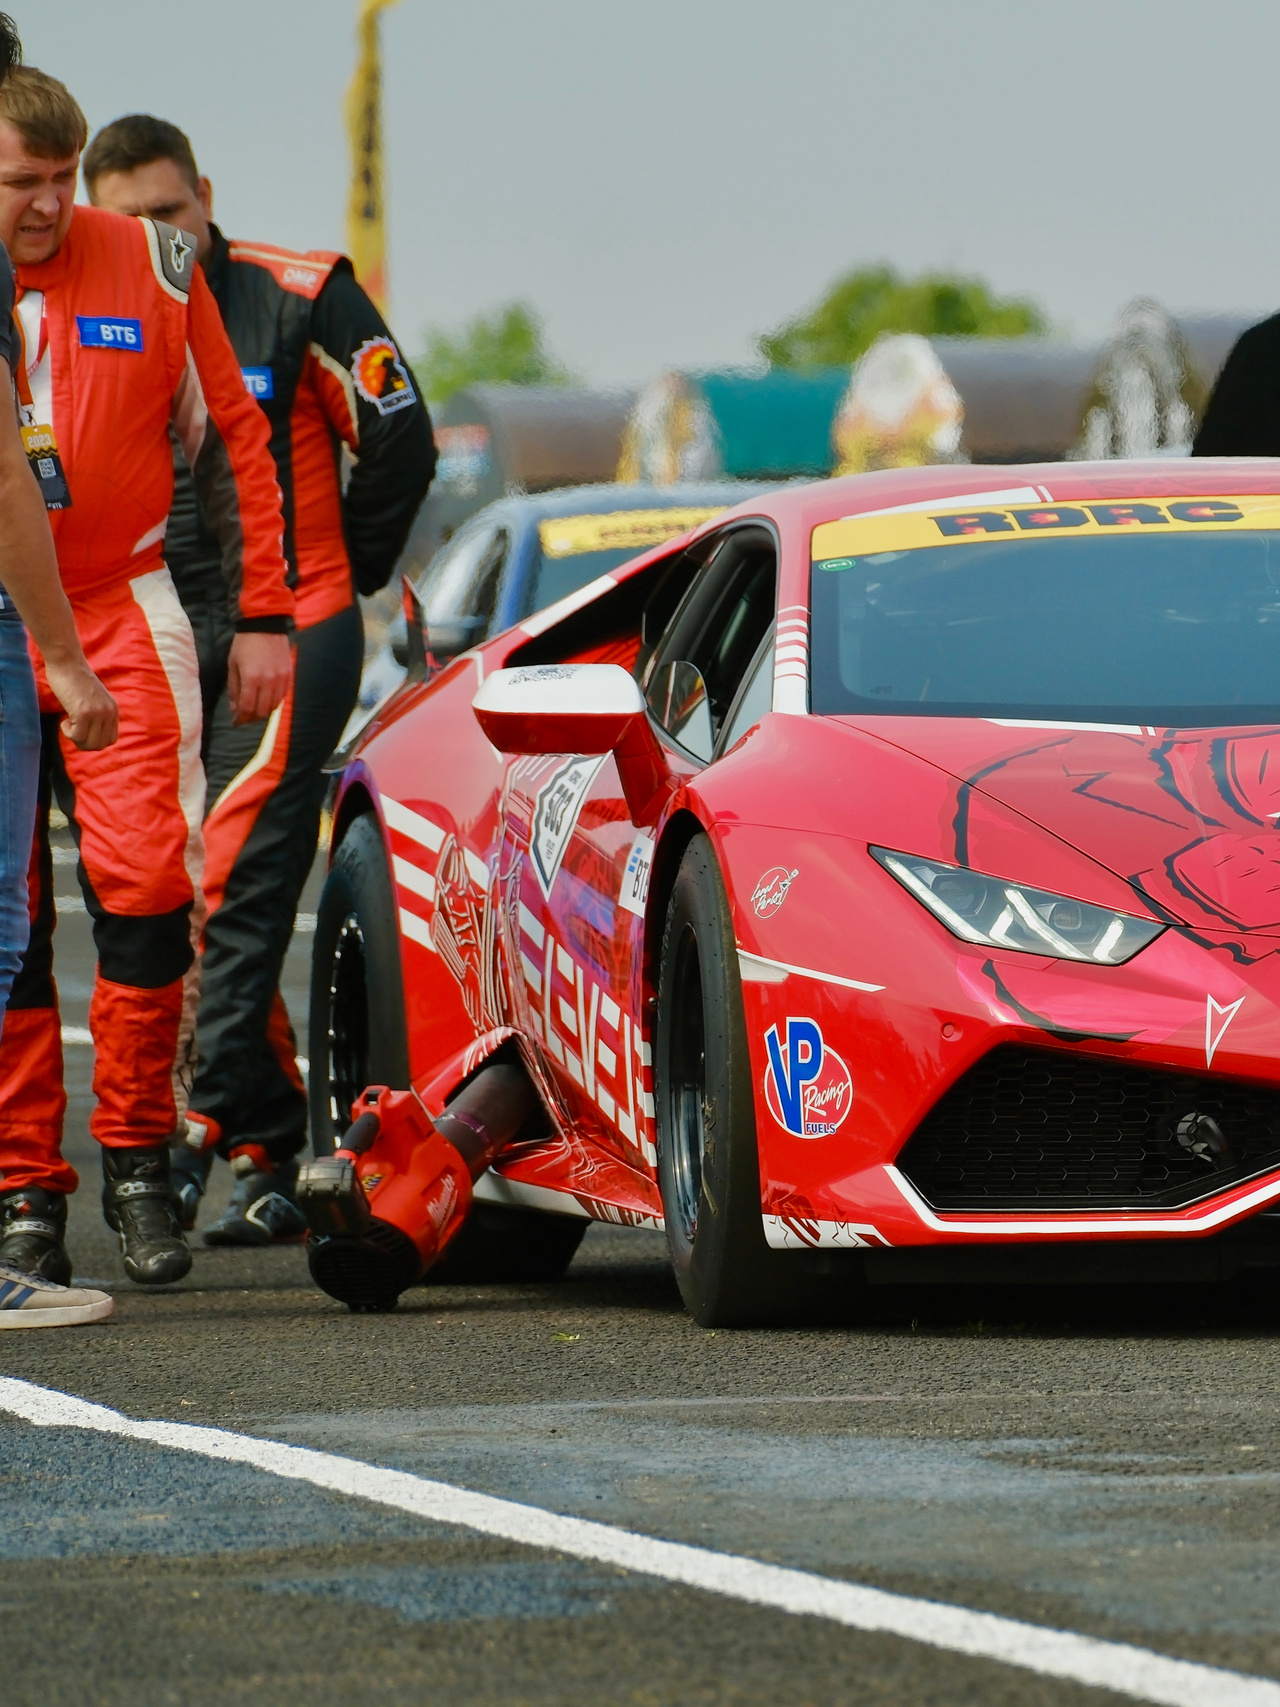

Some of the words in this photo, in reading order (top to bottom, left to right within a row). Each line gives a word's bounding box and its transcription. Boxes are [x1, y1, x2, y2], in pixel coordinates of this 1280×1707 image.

[100, 324, 137, 345] ВТБ
[243, 375, 268, 393] ТБ
[27, 434, 52, 448] 2023
[927, 501, 1245, 537] RDRC
[544, 783, 575, 836] 503
[763, 1016, 825, 1136] VP
[804, 1079, 848, 1121] Racing
[806, 1123, 836, 1134] FUELS
